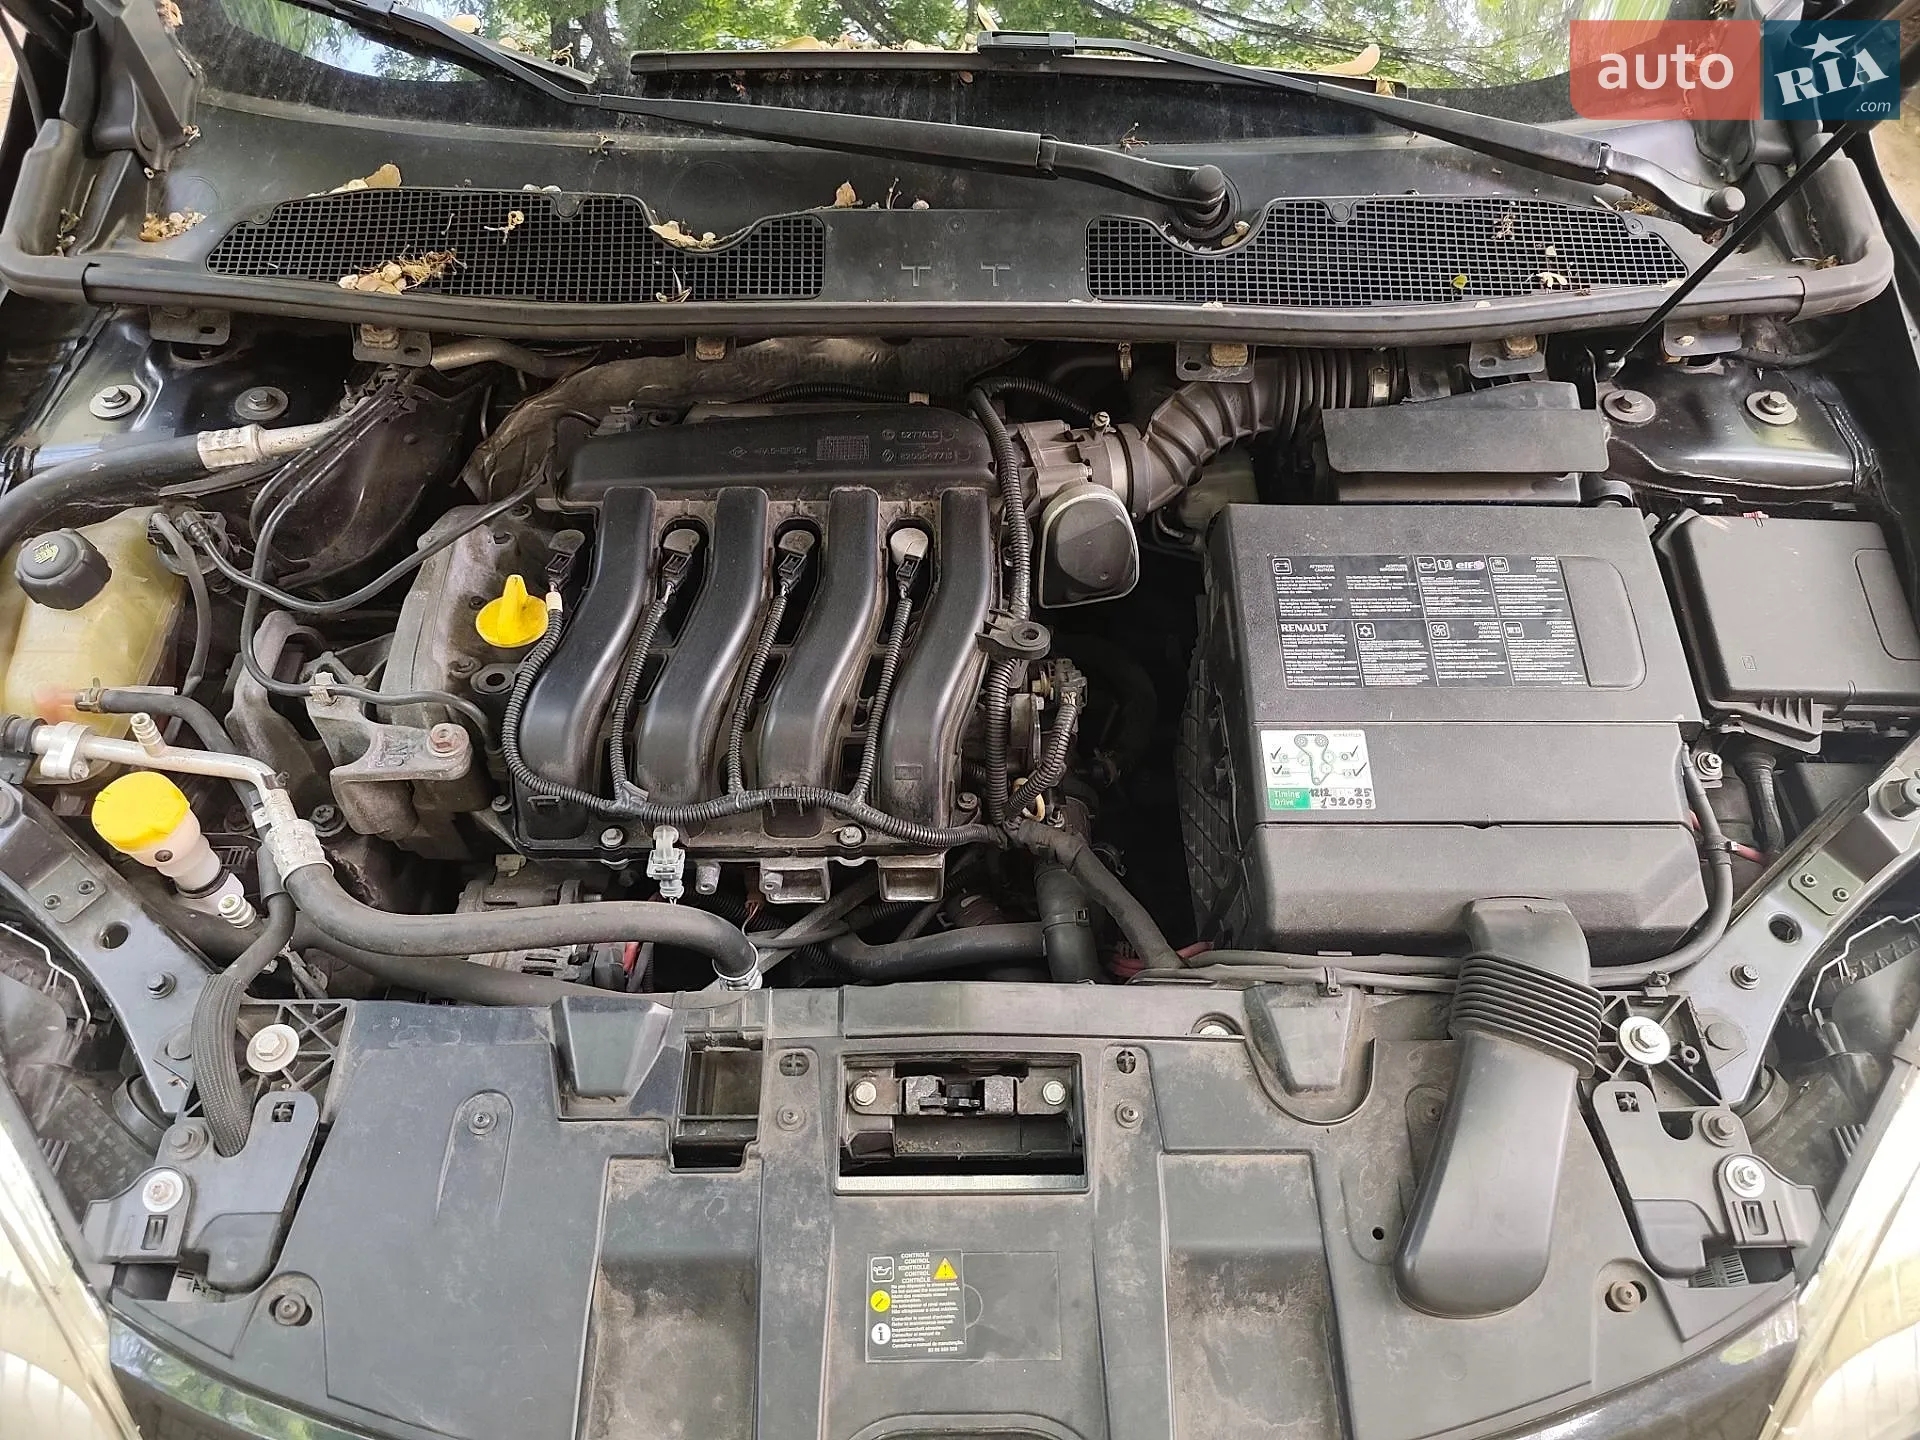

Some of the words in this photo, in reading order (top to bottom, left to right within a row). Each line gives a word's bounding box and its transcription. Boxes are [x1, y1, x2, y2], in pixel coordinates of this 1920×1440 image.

[1280, 623, 1329, 632] RENAULT
[1274, 790, 1301, 799] Timing
[1274, 798, 1295, 806] Drive
